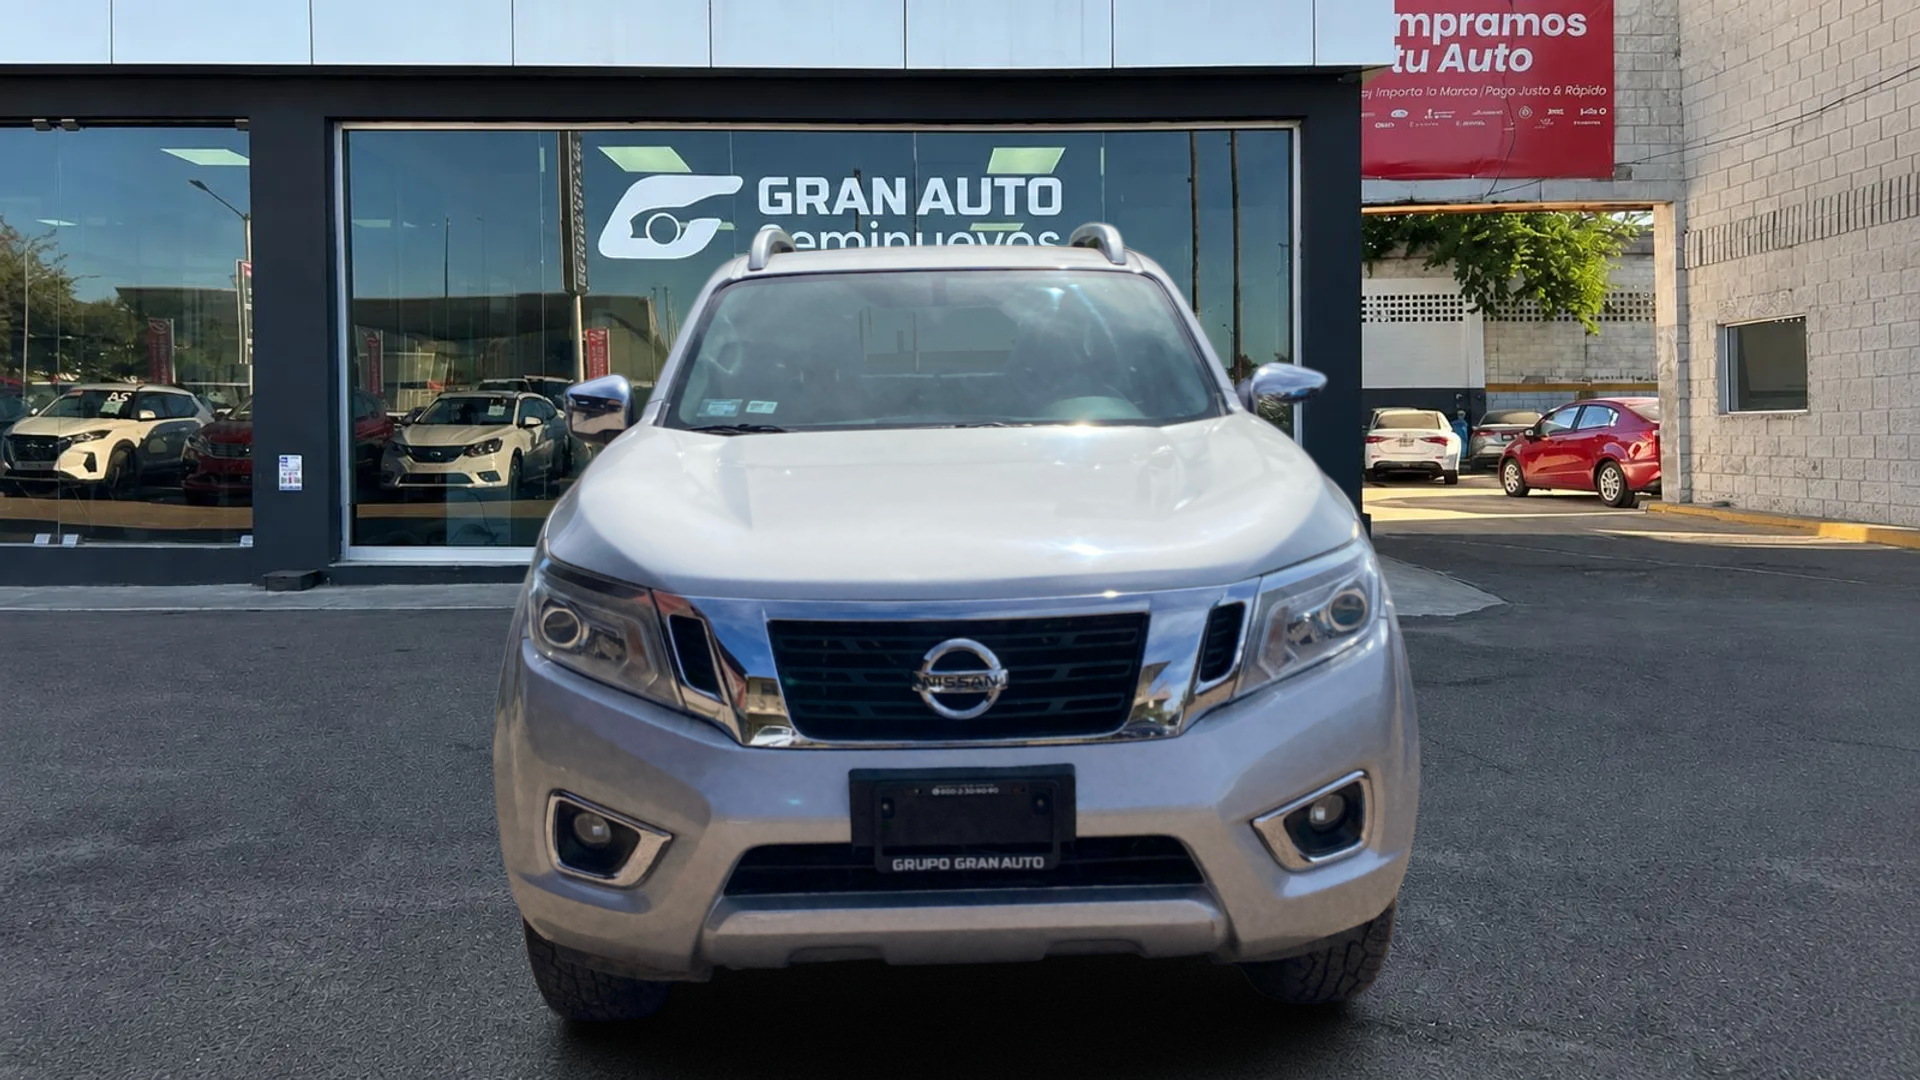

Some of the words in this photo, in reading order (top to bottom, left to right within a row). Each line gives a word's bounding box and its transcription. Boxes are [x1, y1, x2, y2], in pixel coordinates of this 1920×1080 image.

[1392, 44, 1429, 73] tu
[1437, 43, 1533, 73] Auto
[1439, 85, 1478, 97] Marca
[1518, 85, 1551, 97] Justo
[1552, 85, 1562, 96] &
[758, 176, 910, 216] GRAN
[919, 176, 1063, 216] AUTO
[759, 220, 1061, 251] eminuevos
[921, 674, 999, 689] NISSAN
[892, 857, 951, 872] GRUPO
[954, 856, 999, 870] GRAN
[1001, 855, 1045, 870] AUTO
